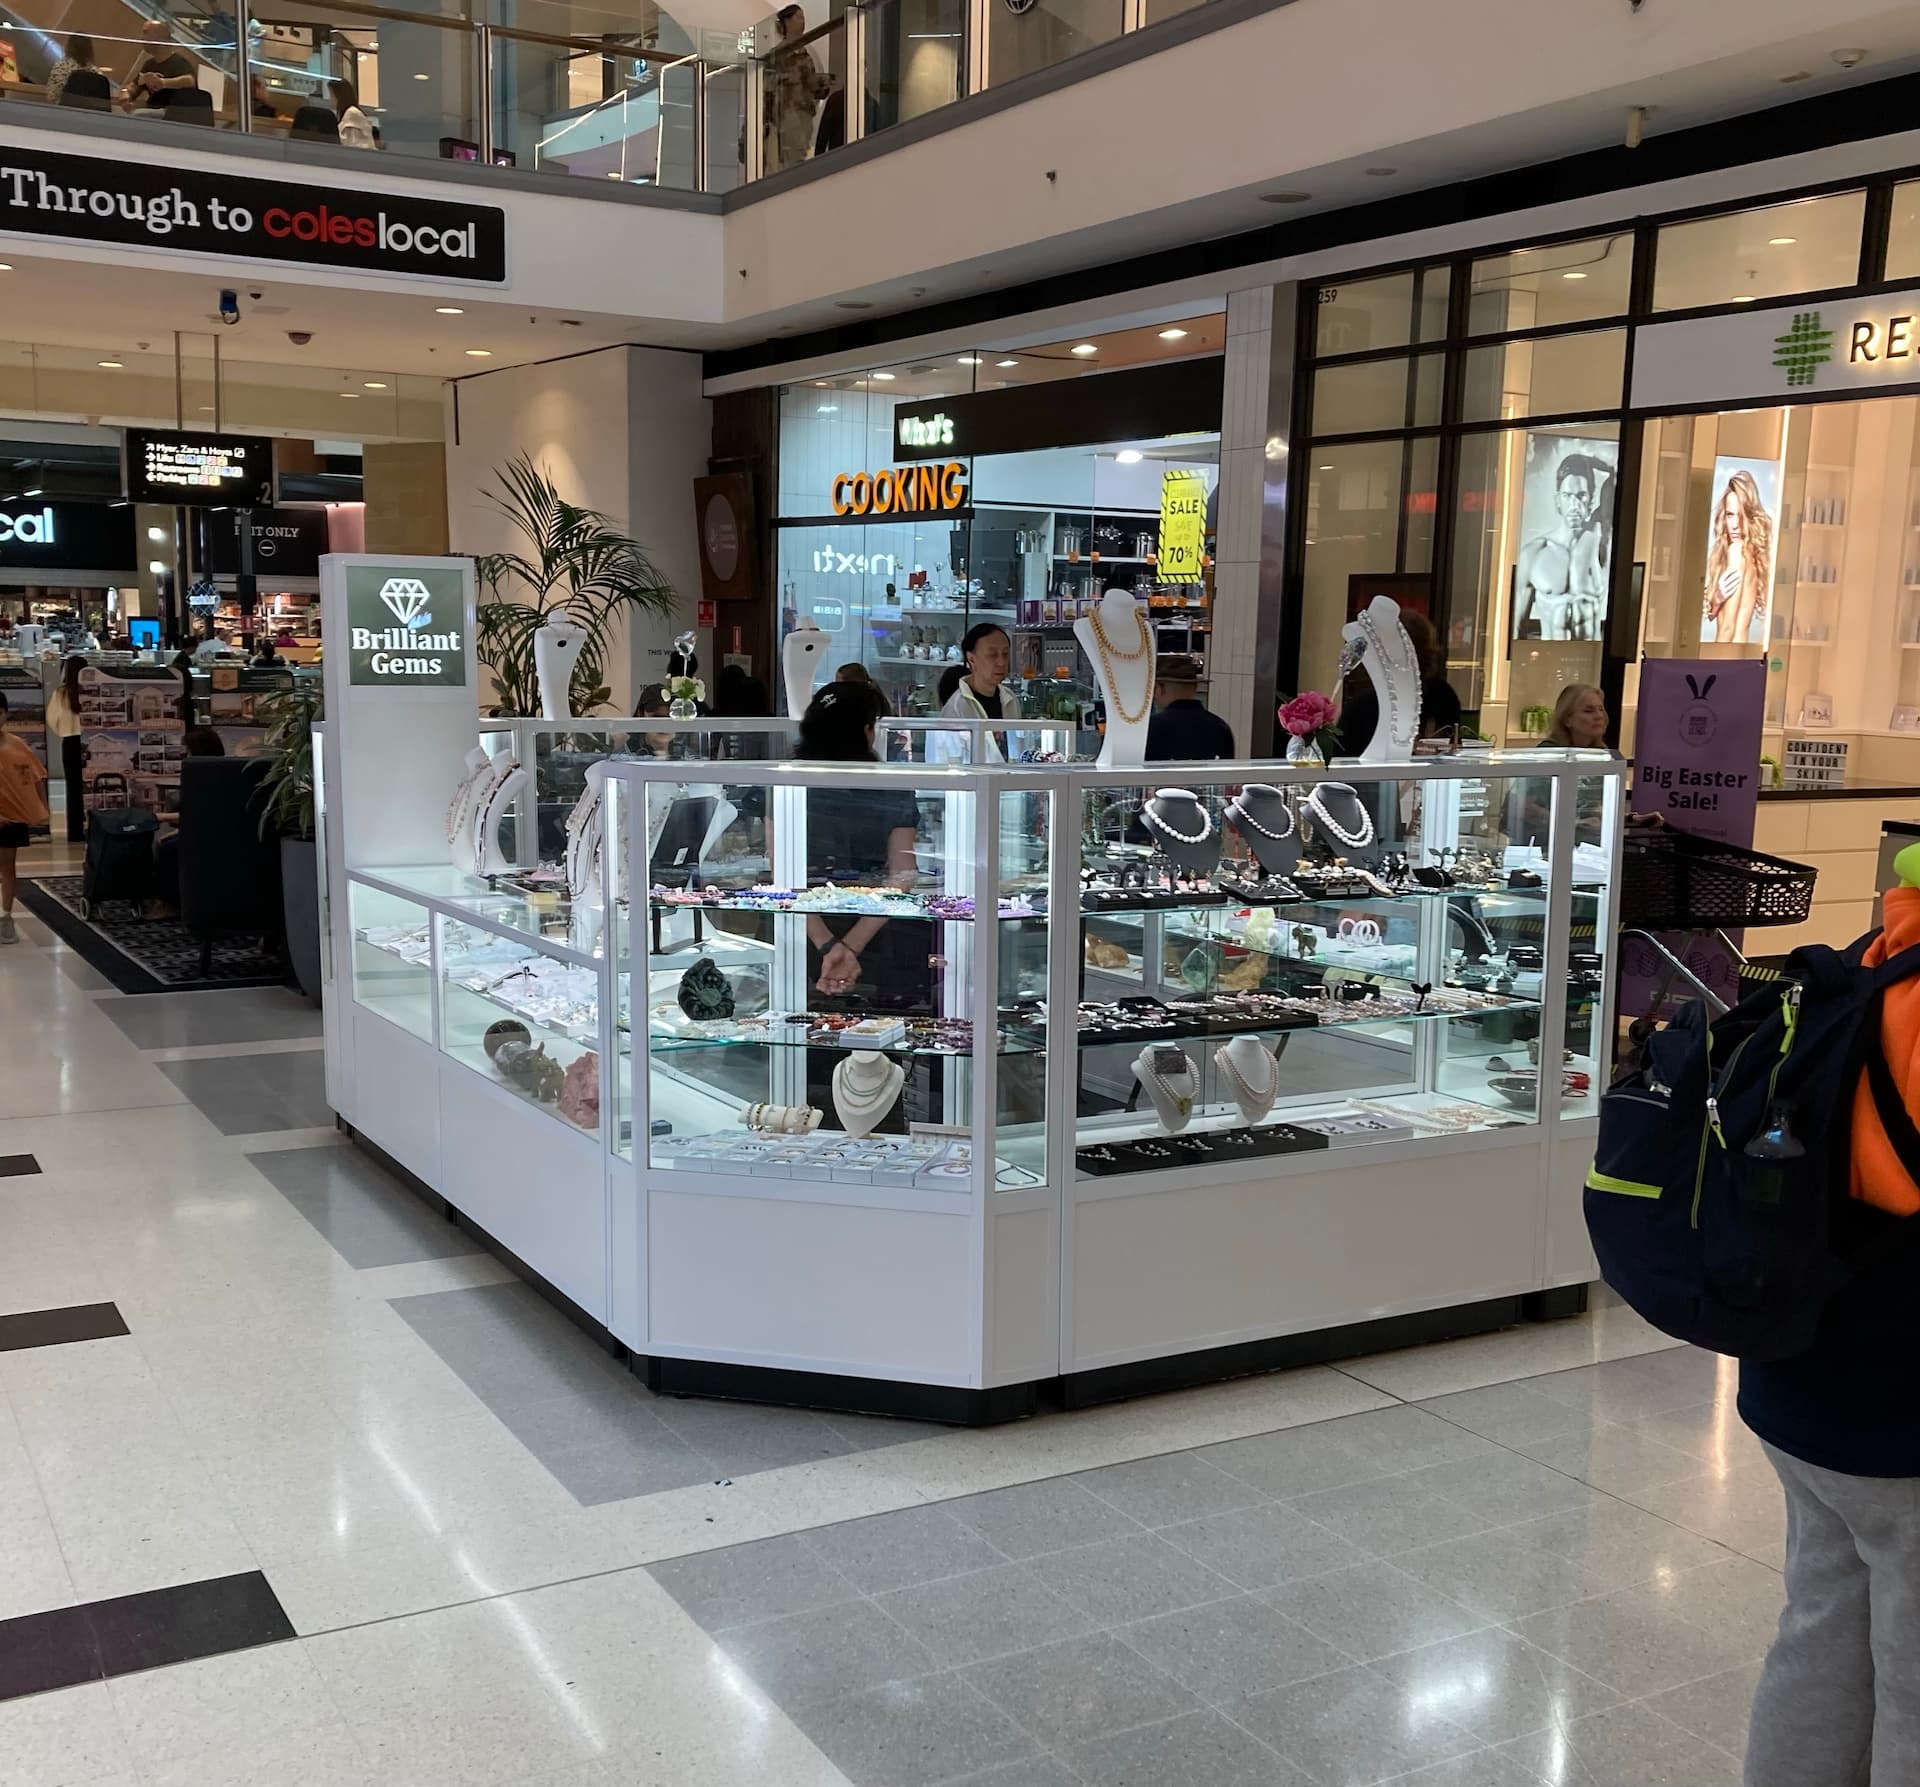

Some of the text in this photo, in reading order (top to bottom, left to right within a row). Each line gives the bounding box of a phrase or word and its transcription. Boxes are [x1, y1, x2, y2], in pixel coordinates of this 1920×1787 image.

[1, 167, 201, 234] Through
[207, 197, 253, 233] to
[1317, 289, 1338, 304] 259
[1849, 315, 1920, 363] RE
[898, 412, 954, 446] What's
[260, 481, 272, 504] 2
[832, 462, 967, 516] COOKING
[1169, 499, 1199, 515] SALE
[234, 526, 300, 538] EIT ONLY
[1169, 546, 1193, 564] 70%
[351, 627, 461, 651] Brilliant
[371, 652, 442, 675] Gems
[1787, 742, 1848, 755] CONFIDENT
[1793, 755, 1839, 768] IN YOUR
[1642, 765, 1748, 789] Big Easter
[1796, 768, 1830, 781] SKIN!
[1667, 791, 1718, 811] Sale!
